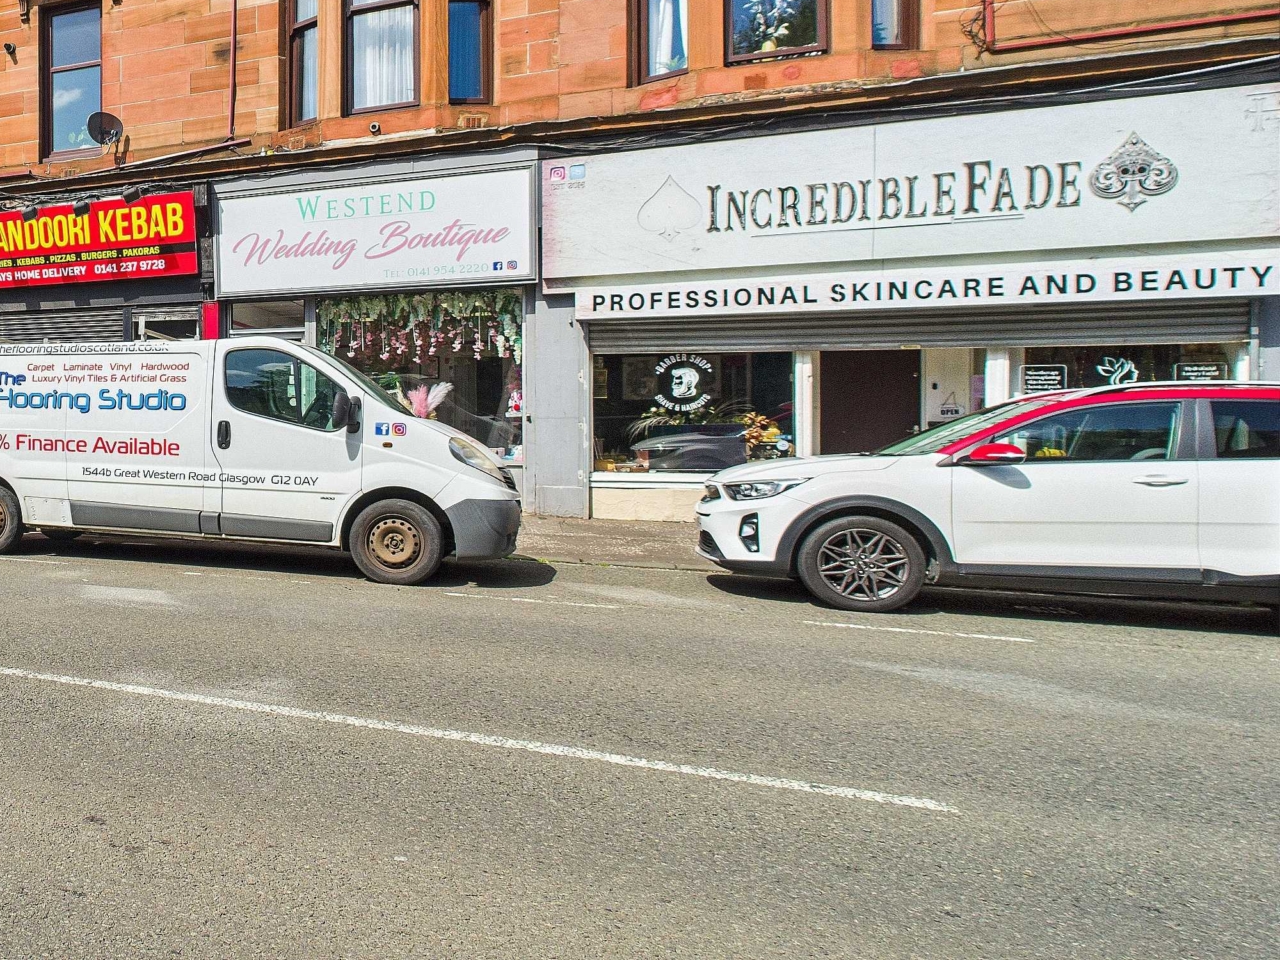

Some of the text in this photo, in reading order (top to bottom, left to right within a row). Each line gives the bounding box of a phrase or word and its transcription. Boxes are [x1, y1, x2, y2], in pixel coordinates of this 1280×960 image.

[295, 190, 437, 221] WESTEND
[98, 202, 184, 243] KEBAB
[232, 218, 511, 271] Wedding Boutique
[17, 256, 45, 266] KEBABS
[50, 253, 76, 263] PIZZAS
[81, 250, 118, 261] BURGERS
[123, 246, 160, 257] PAKORAS
[14, 269, 41, 281] HOME
[42, 266, 87, 279] DELIVERY
[94, 263, 118, 275] 0141
[120, 261, 137, 272] 237
[139, 259, 166, 271] 9728
[407, 267, 431, 278] 0141
[433, 264, 457, 276] 954
[459, 262, 489, 275] 2220
[591, 265, 1274, 313] PROFESSIONAL SKINCARE AND BEAUTY
[27, 362, 190, 373] Carpet Laminate Vinyl Hardwood
[655, 353, 712, 373] BARBER SHOP
[32, 373, 187, 384] Luxury Vinyl Tiles & Artificial Grass
[98, 388, 187, 411] Studio
[654, 394, 675, 410] SHAVE
[940, 408, 960, 416] OPEN
[15, 433, 88, 453] Finance
[92, 436, 181, 457] Available
[81, 466, 113, 477] 1544b
[114, 468, 141, 478] Great
[142, 469, 187, 481] Western
[187, 471, 217, 482] Road
[219, 472, 266, 486] Glasgow
[270, 474, 292, 486] G12
